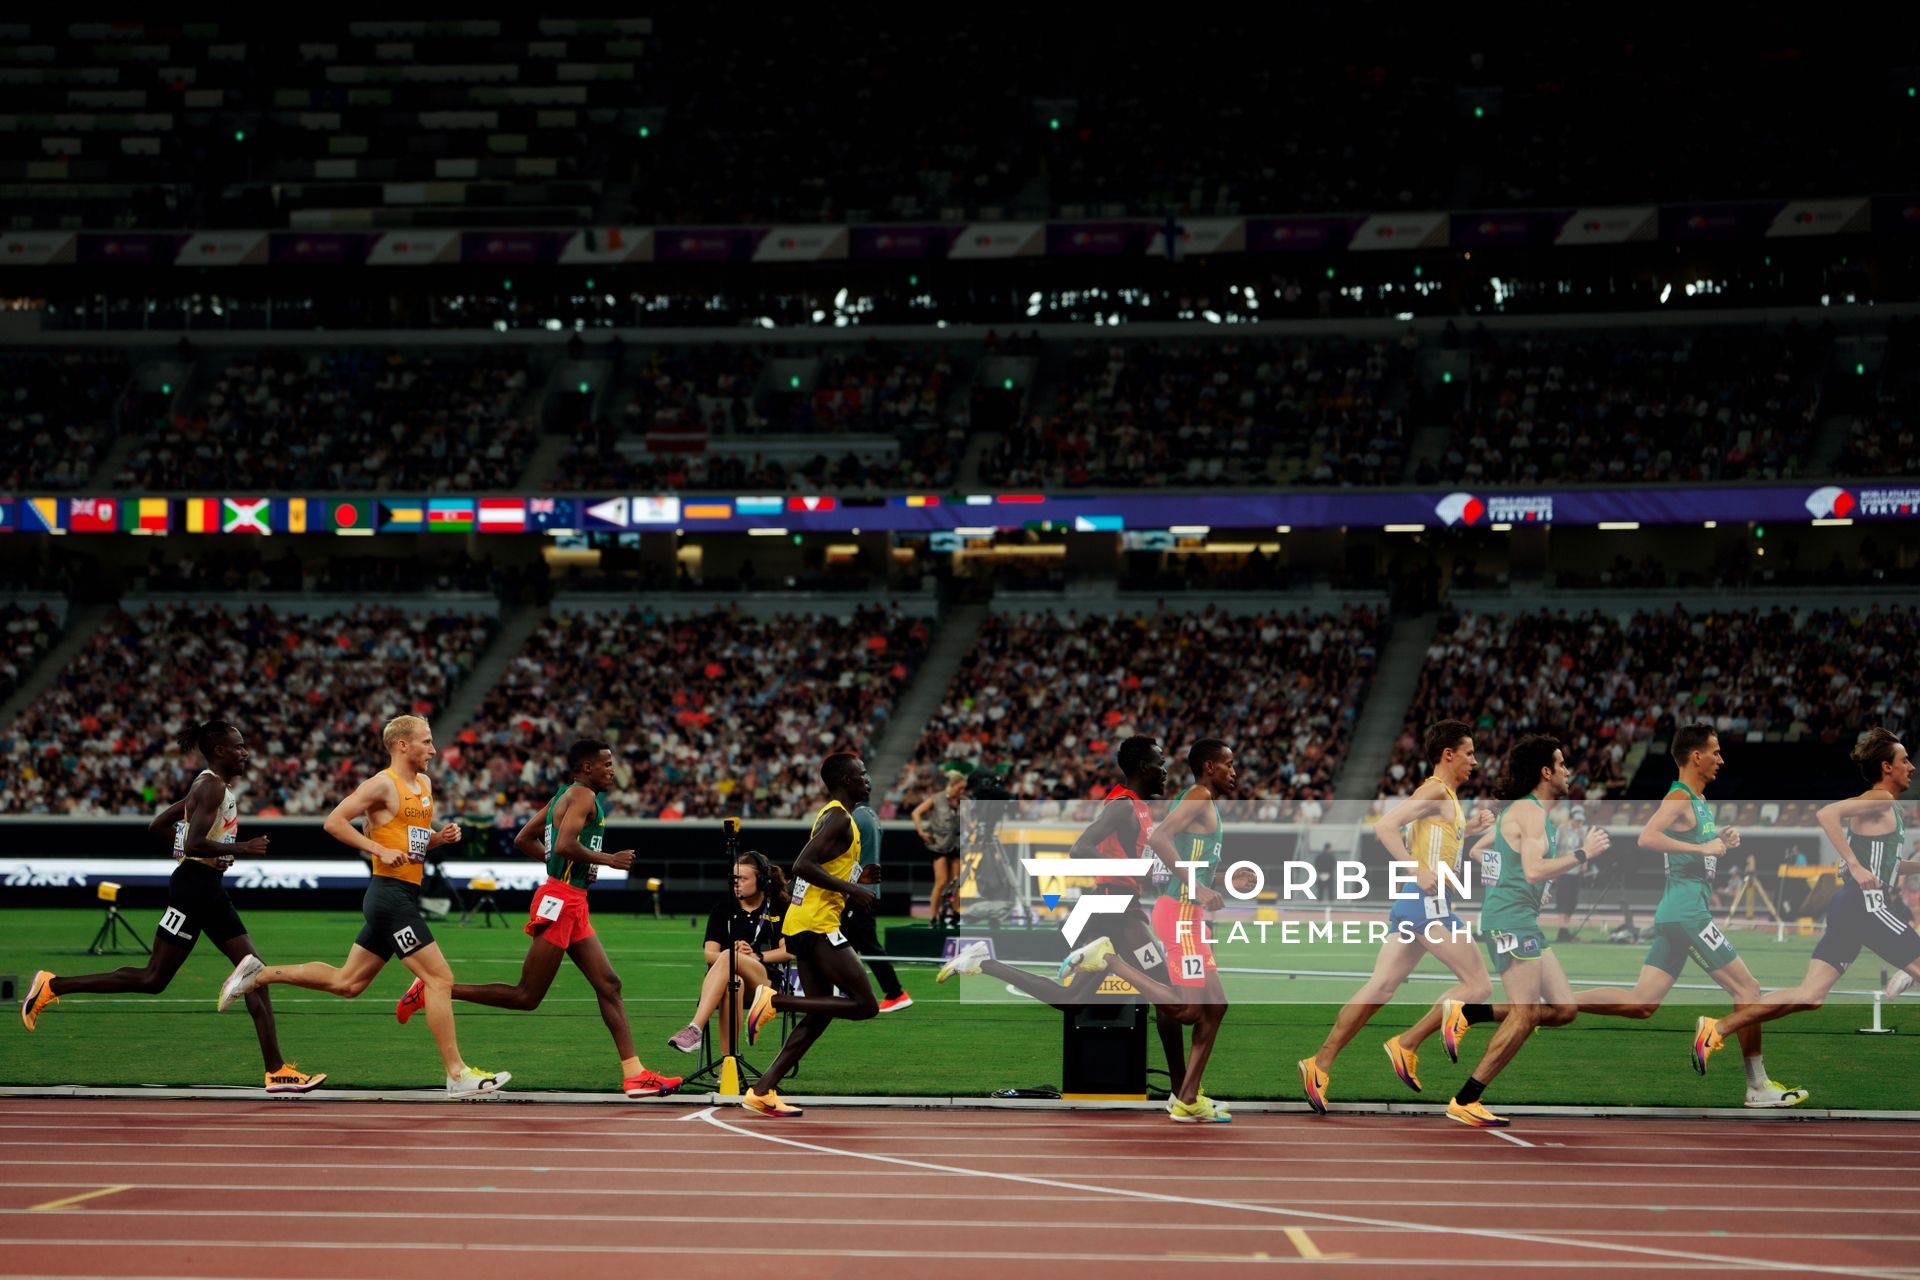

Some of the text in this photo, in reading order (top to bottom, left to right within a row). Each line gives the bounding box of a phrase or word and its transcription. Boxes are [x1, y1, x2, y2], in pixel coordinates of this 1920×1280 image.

[547, 900, 557, 915] 7
[1432, 899, 1441, 915] 1
[1866, 893, 1884, 909] 19
[165, 911, 181, 930] 11
[397, 930, 417, 949] 18
[1500, 934, 1513, 949] 17
[1703, 926, 1722, 946] 14
[1143, 949, 1155, 964] 4
[1184, 959, 1202, 975] 12
[269, 1076, 300, 1084] NITRO
